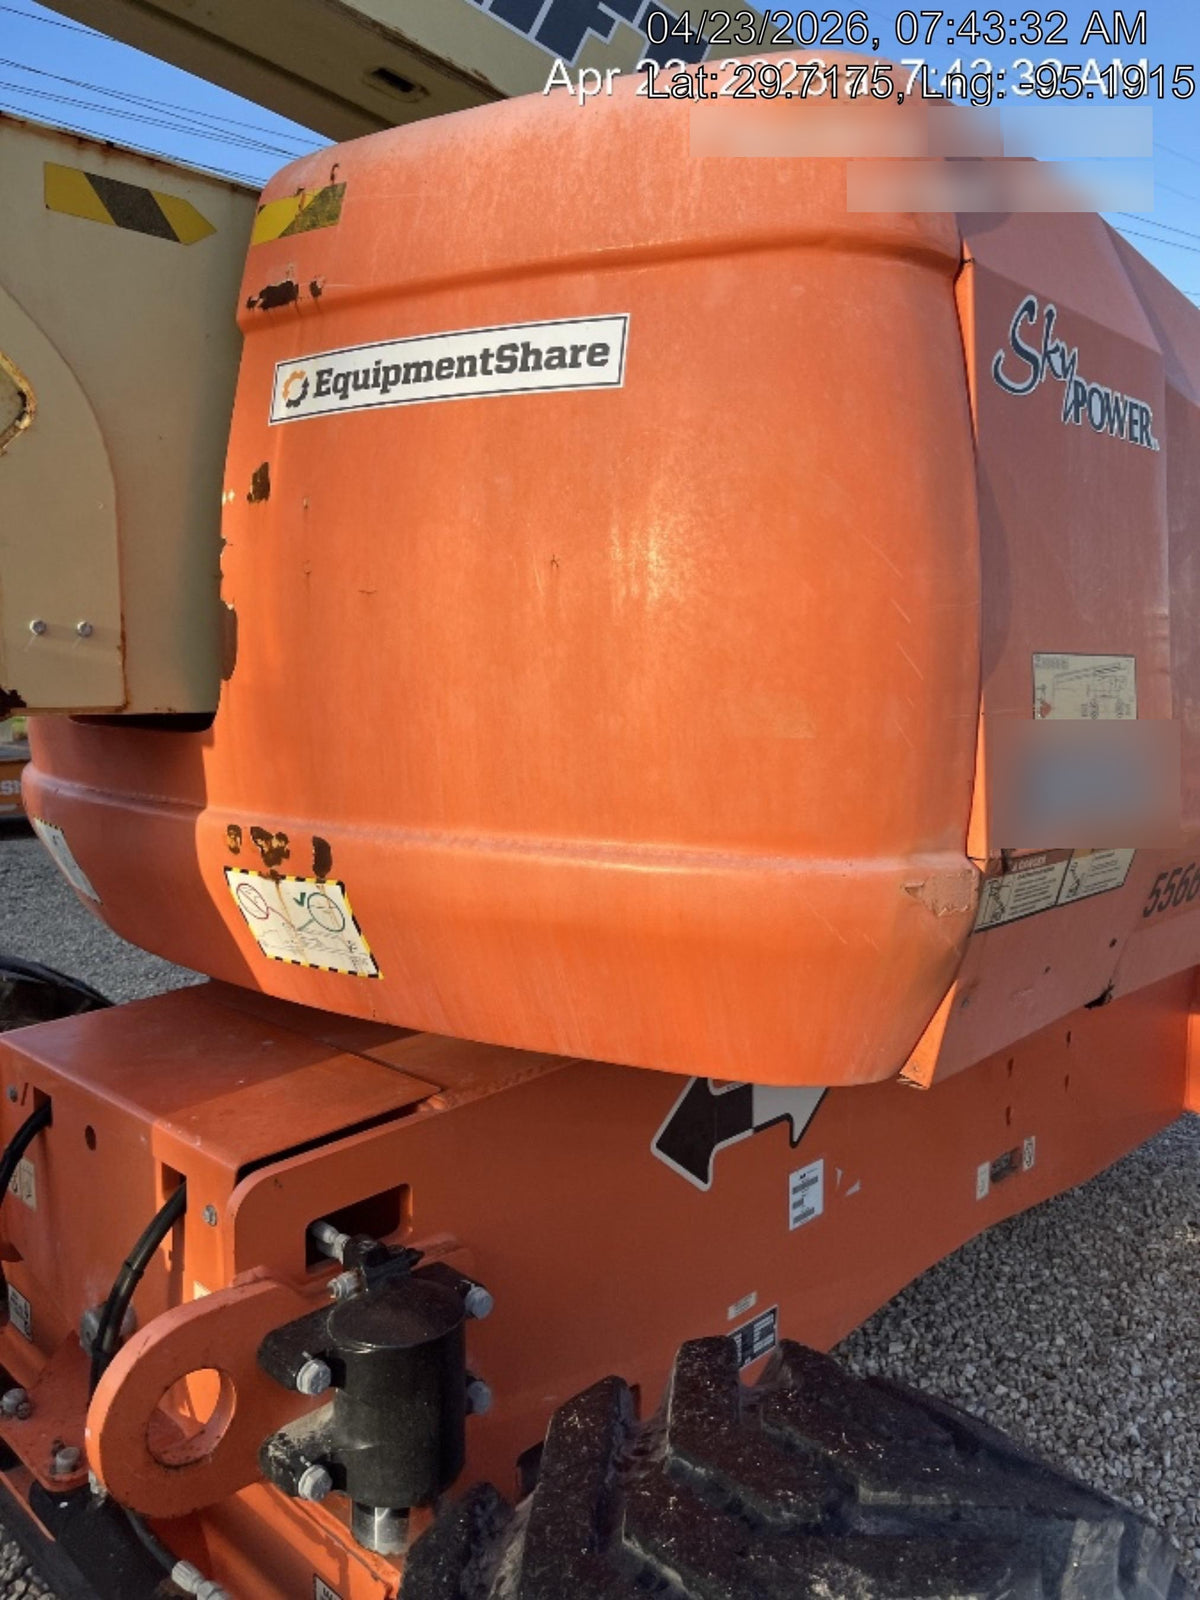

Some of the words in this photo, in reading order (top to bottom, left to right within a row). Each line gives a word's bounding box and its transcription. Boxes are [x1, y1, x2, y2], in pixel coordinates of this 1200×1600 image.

[312, 341, 611, 400] EquipmentShare
[992, 294, 1079, 425] Sky
[1071, 377, 1154, 450] POWER
